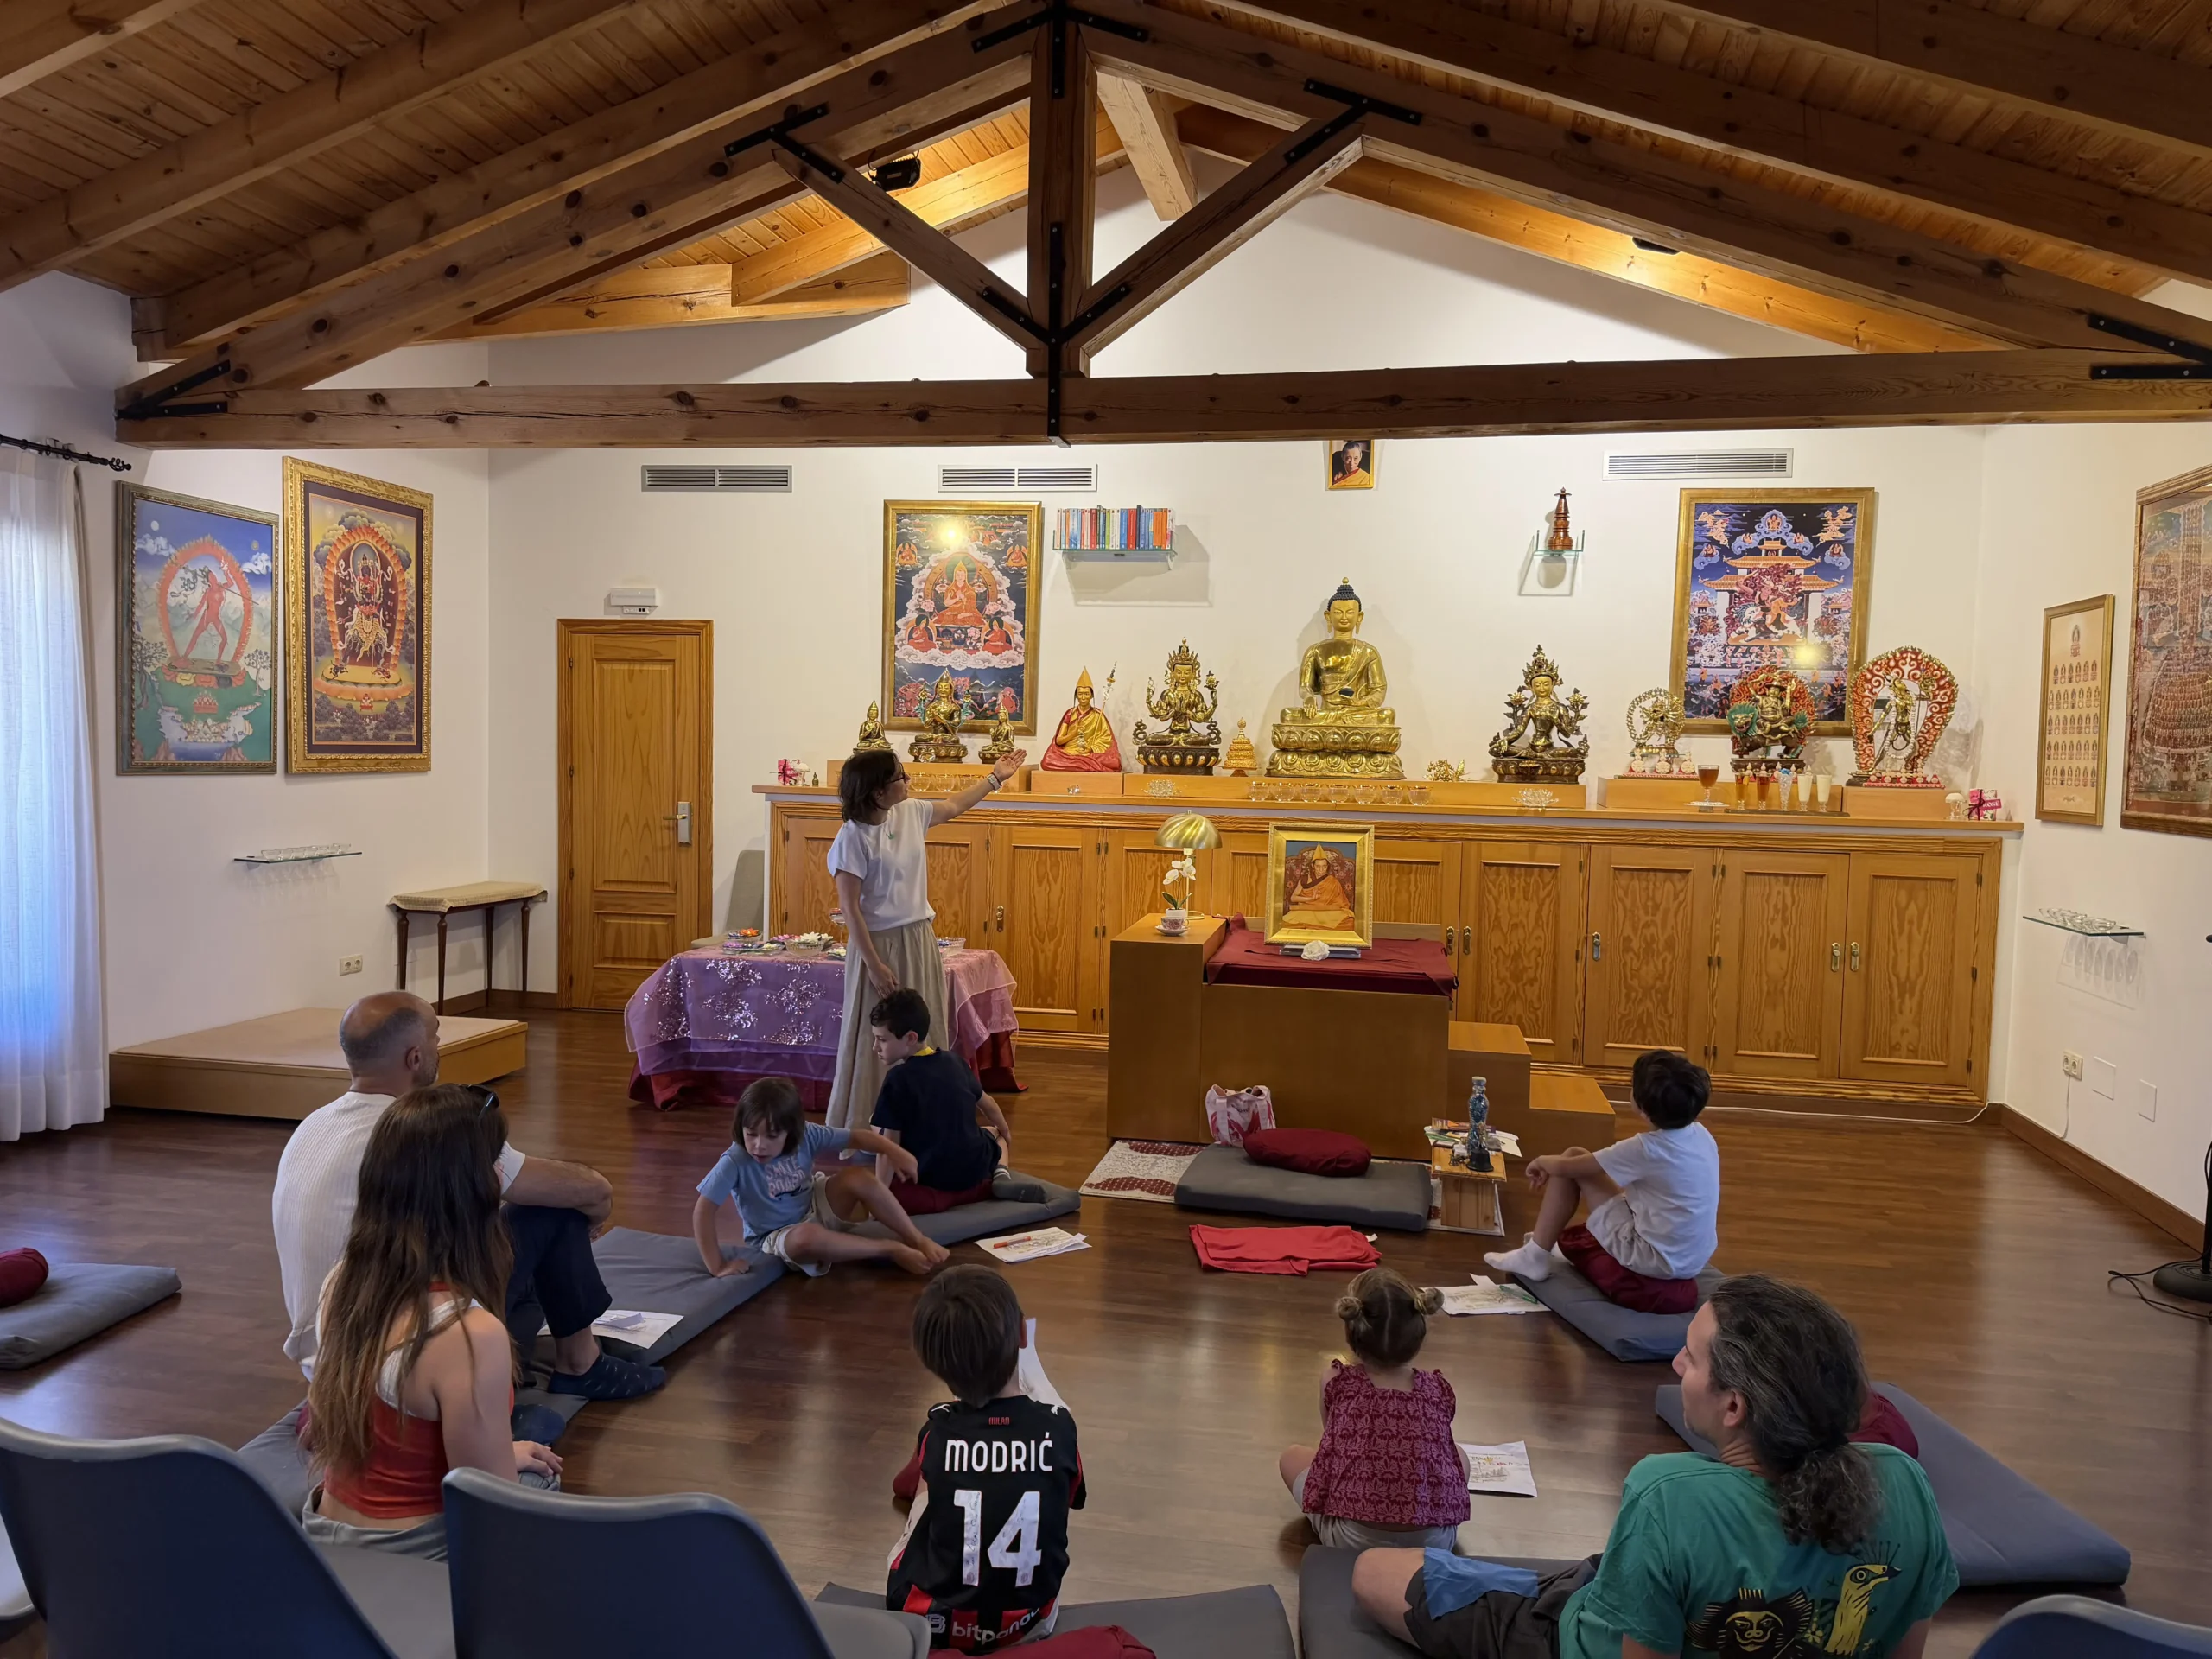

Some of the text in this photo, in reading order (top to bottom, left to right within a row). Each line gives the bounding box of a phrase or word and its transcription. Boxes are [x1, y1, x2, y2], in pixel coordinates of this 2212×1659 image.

[988, 1416, 1010, 1426] MILAN
[944, 1431, 1053, 1473] MODRIĆ
[954, 1489, 1042, 1587] 14
